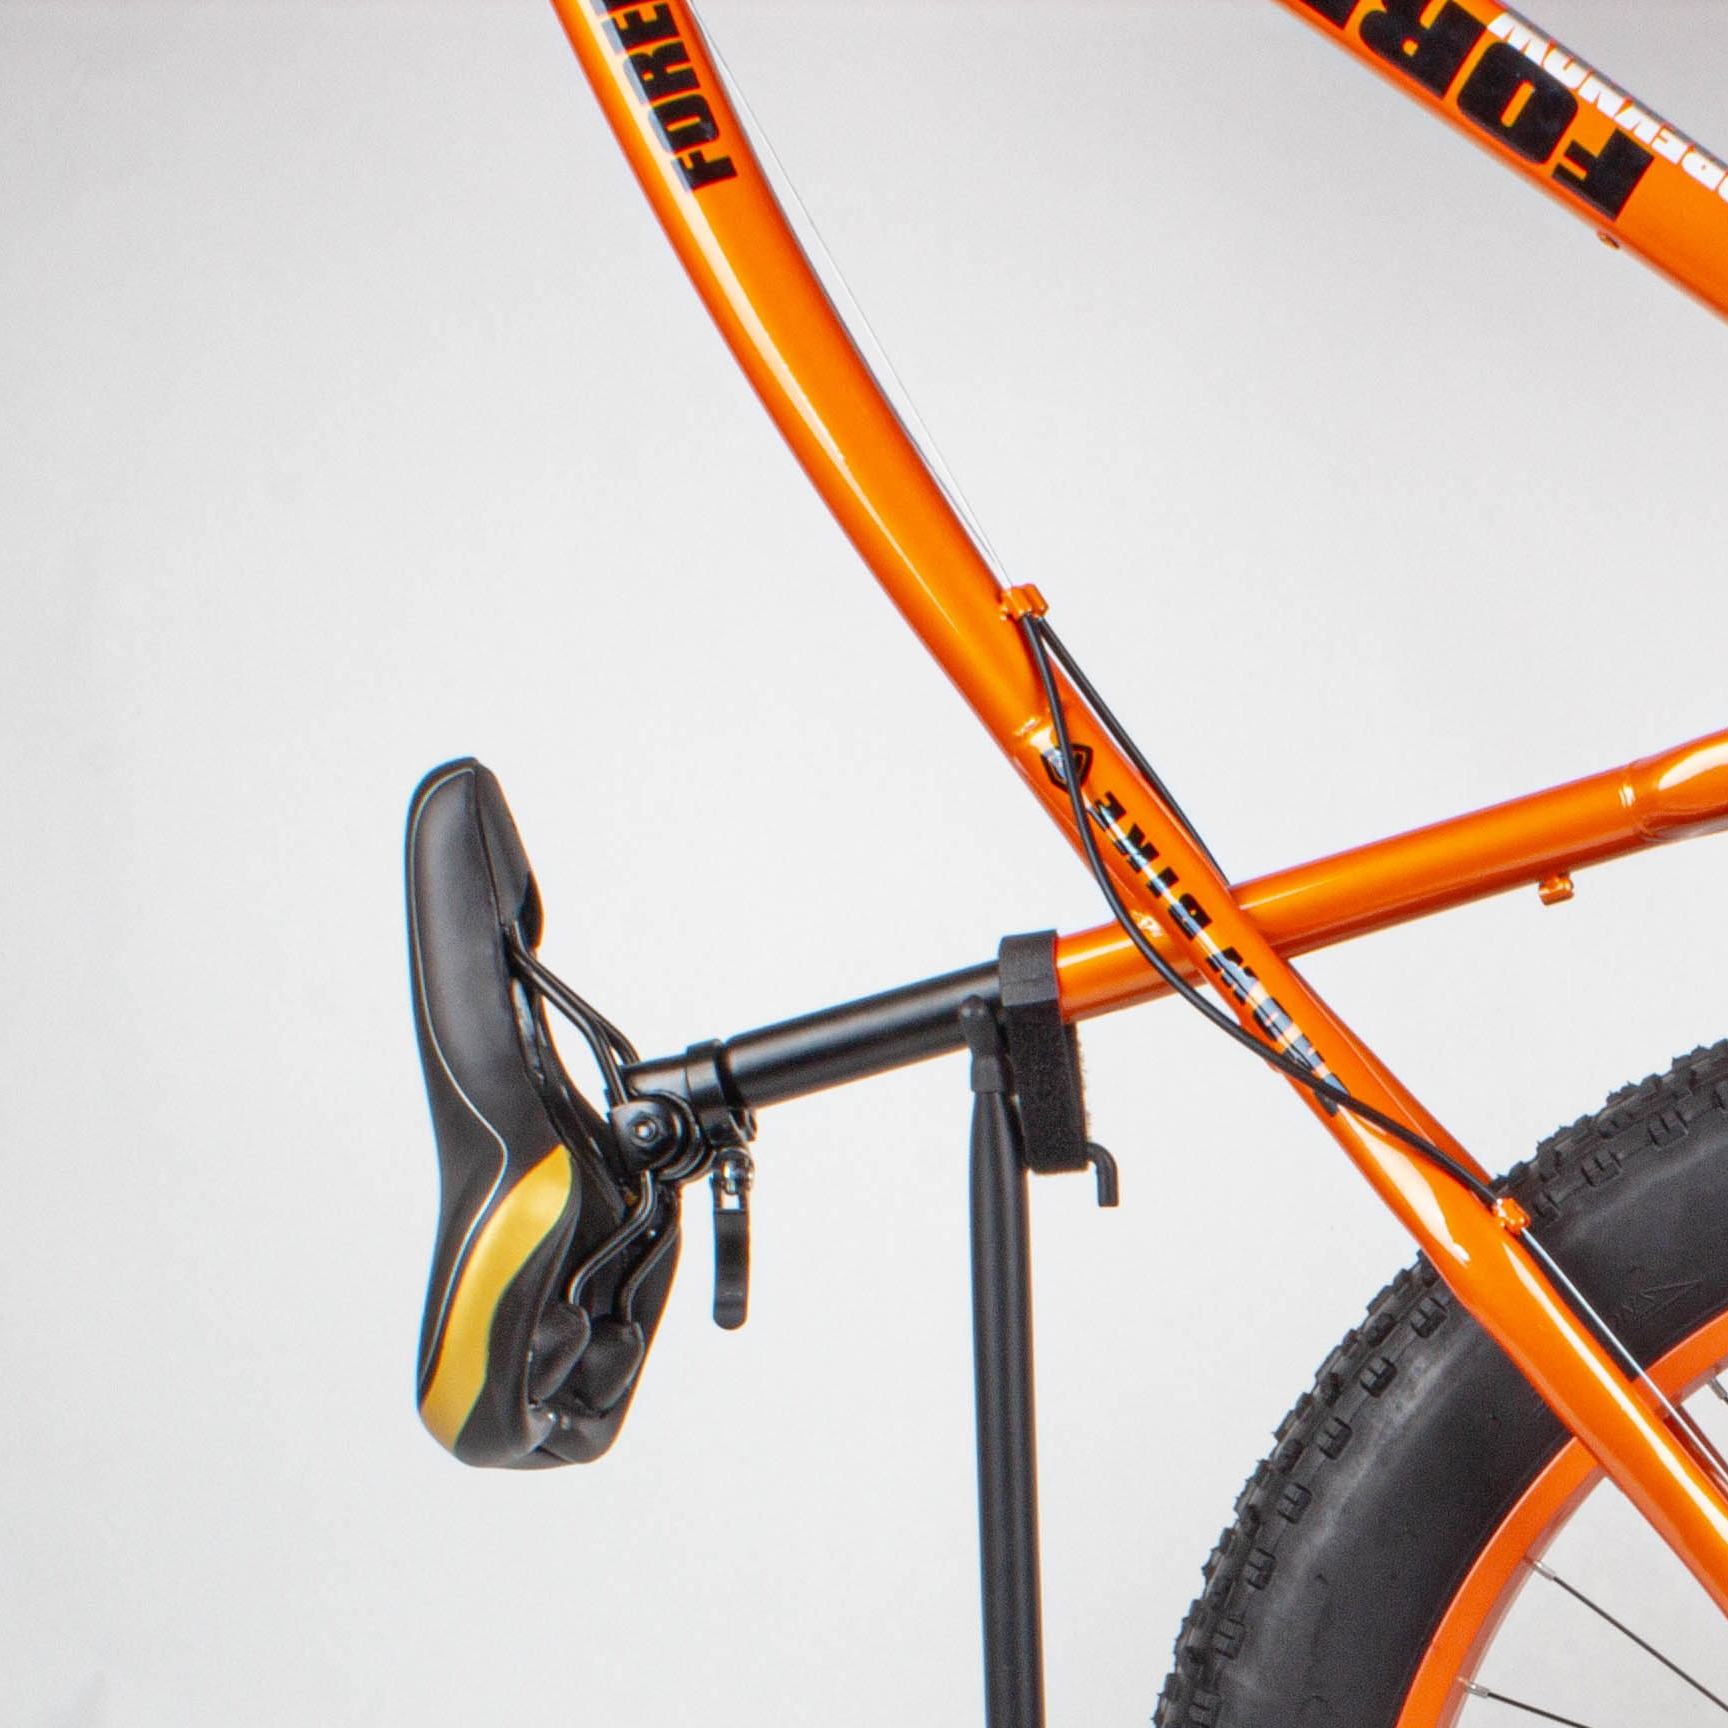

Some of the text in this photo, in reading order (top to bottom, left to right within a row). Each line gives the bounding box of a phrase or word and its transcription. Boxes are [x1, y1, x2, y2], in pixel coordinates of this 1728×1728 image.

[593, 0, 738, 193] FORE
[1303, 0, 1655, 222] FOR
[1085, 791, 1213, 940] BIKE
